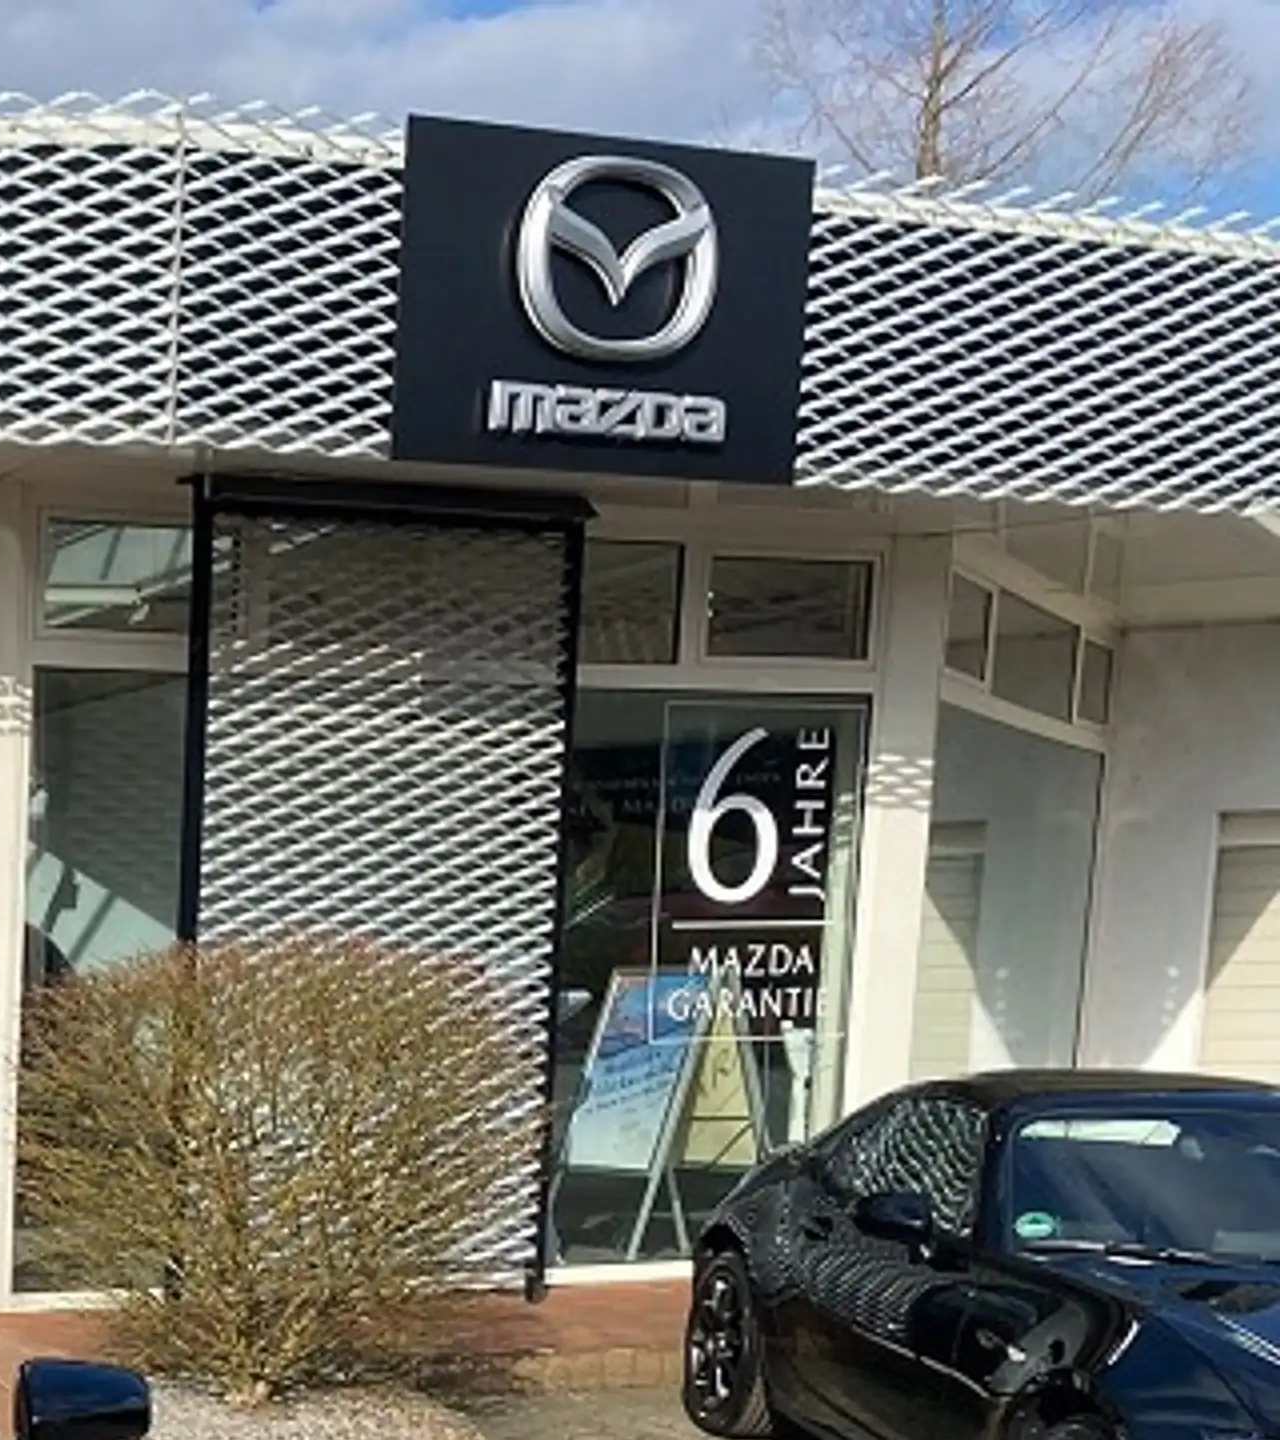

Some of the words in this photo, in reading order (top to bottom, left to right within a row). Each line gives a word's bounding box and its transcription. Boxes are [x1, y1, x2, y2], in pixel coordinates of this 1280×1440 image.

[487, 379, 728, 444] mazda
[687, 727, 779, 904] 6
[788, 727, 830, 901] JAHRE
[689, 944, 815, 978] MAZDA
